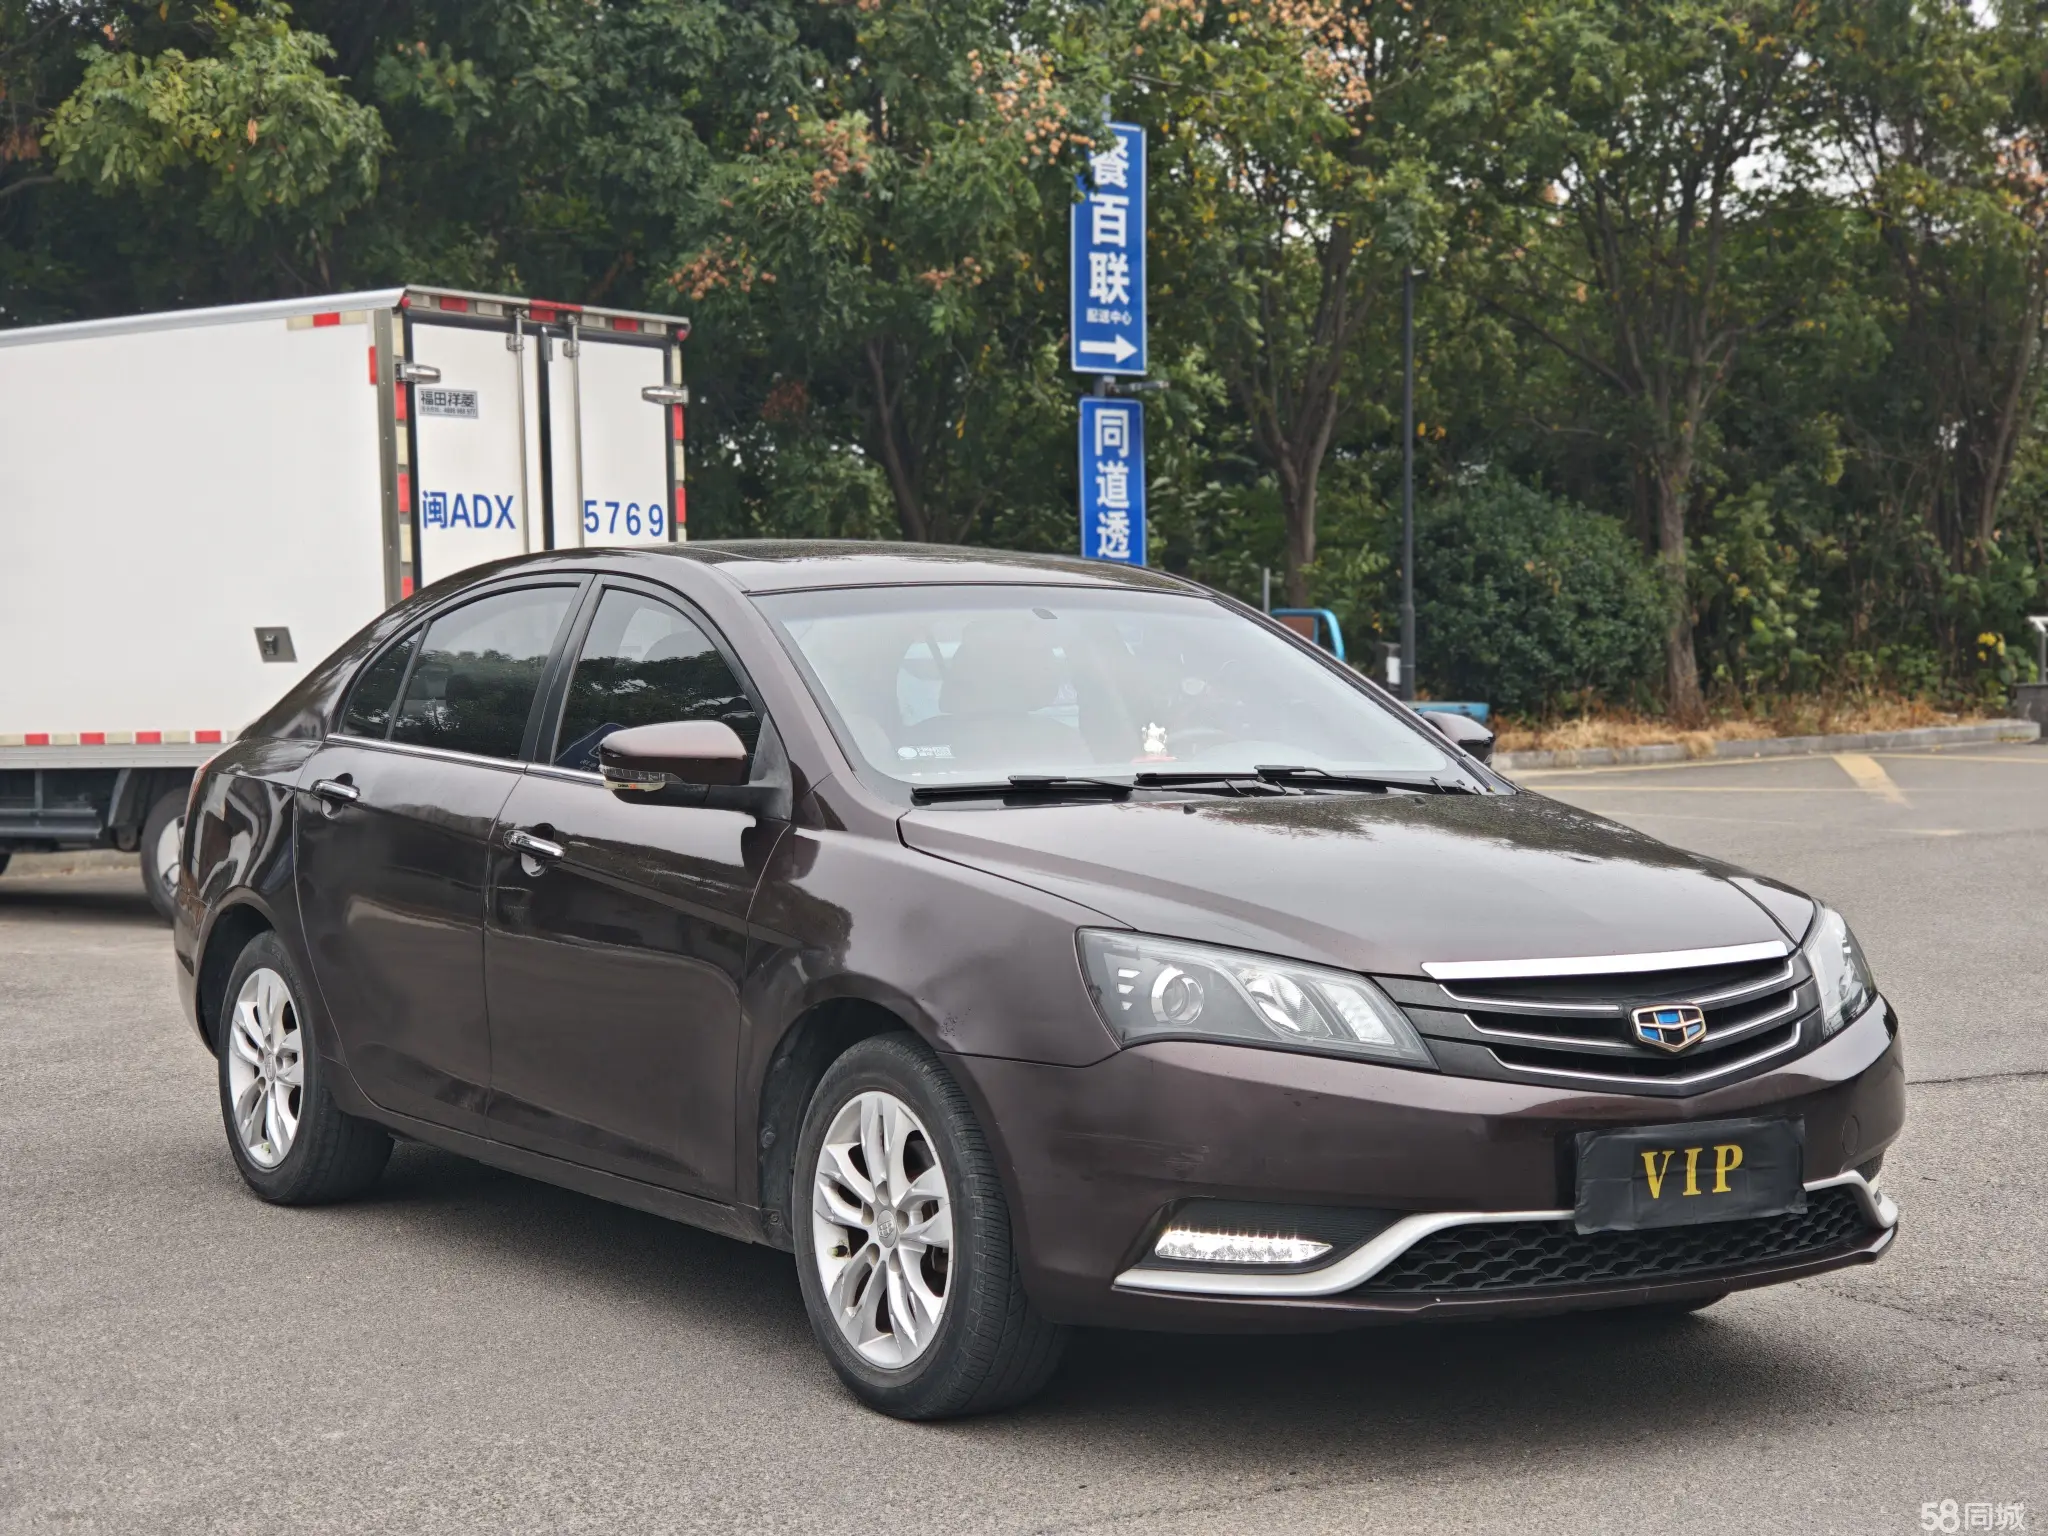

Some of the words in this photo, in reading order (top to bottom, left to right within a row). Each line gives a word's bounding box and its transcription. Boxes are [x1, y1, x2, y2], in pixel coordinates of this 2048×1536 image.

[1095, 408, 1131, 558] 同道透
[422, 490, 516, 529] 闽ADX
[584, 500, 664, 537] 5769
[1640, 1144, 1744, 1199] VIP
